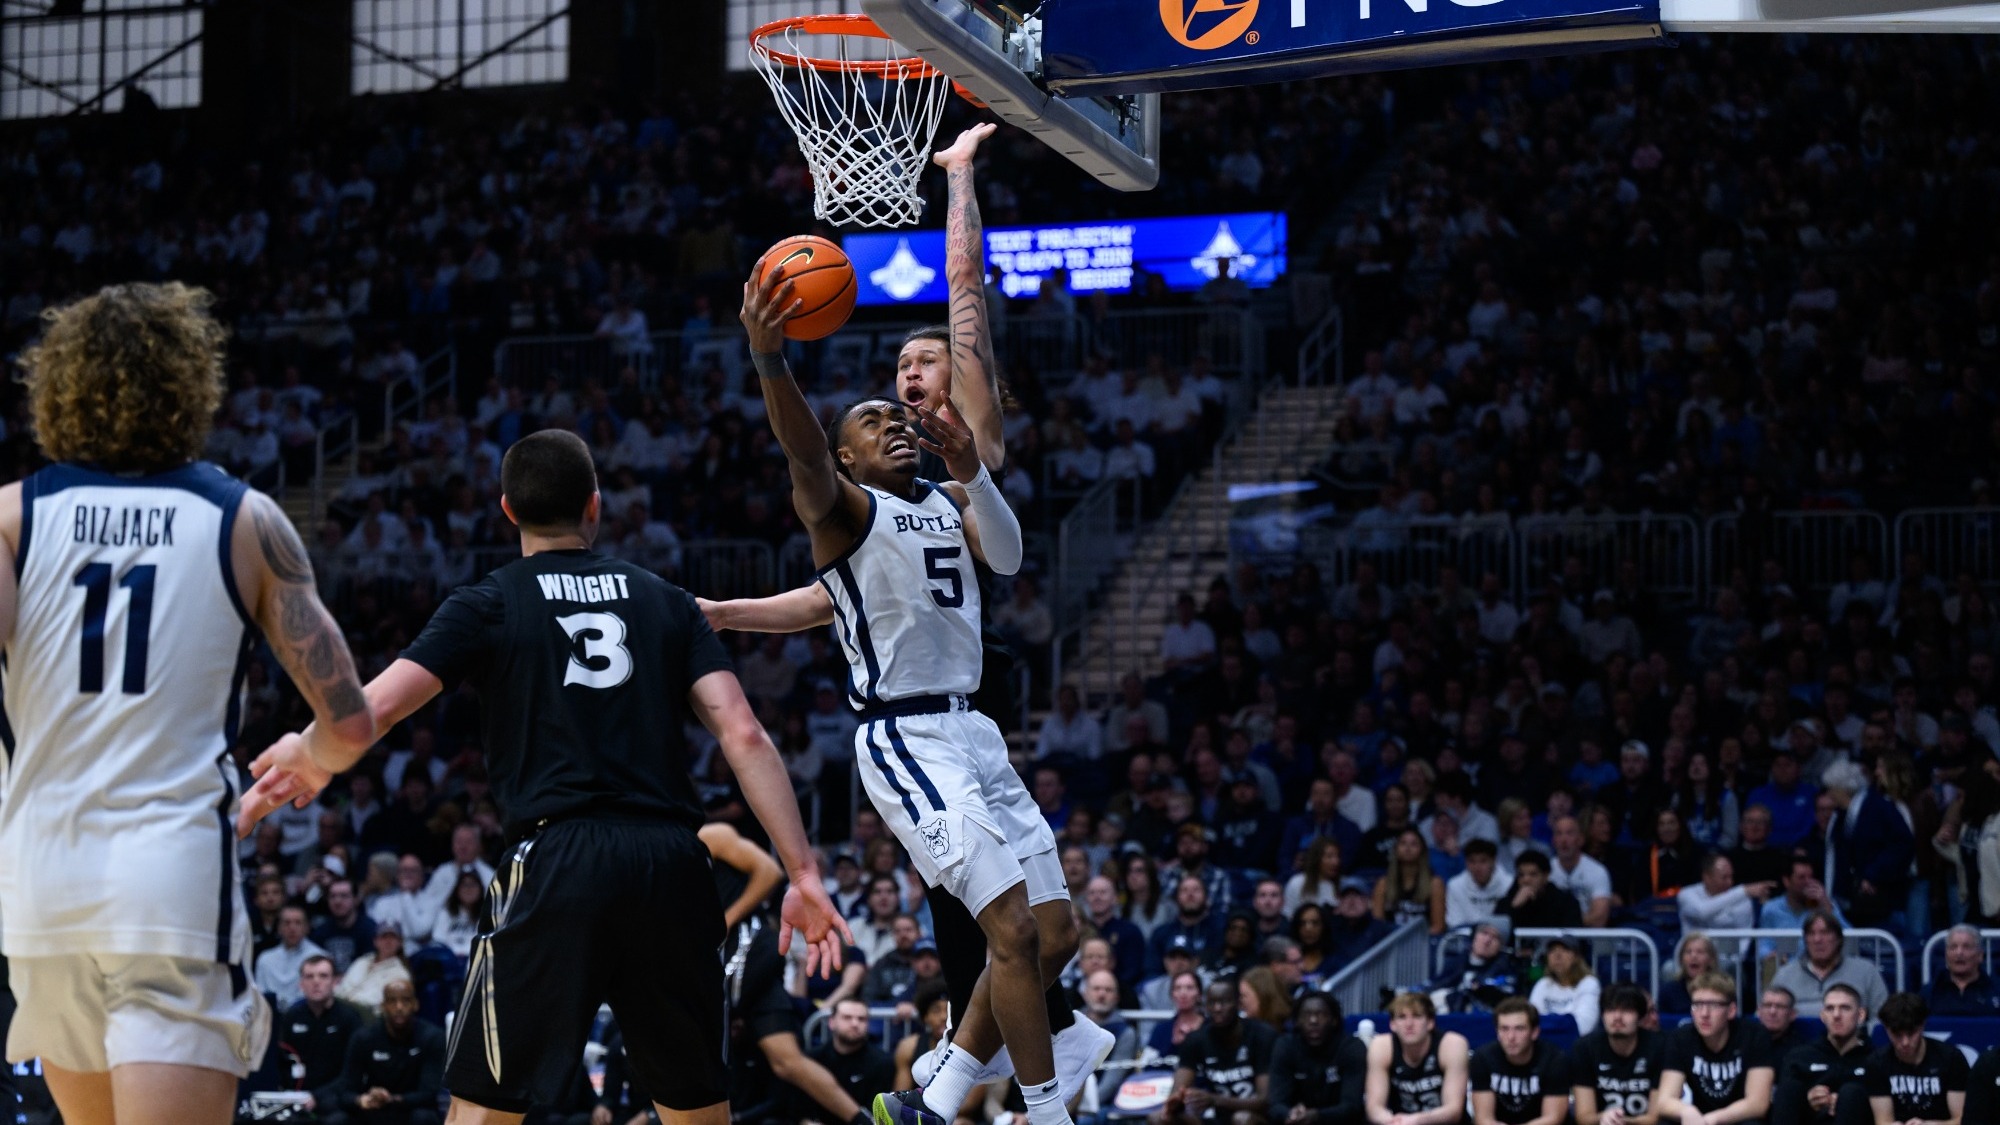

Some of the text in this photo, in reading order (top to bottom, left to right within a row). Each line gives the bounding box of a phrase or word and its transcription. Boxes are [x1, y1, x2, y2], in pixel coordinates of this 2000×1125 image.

[74, 505, 176, 547] BIZJACK
[536, 573, 630, 603] WRIGHT
[923, 546, 964, 608] 5
[74, 563, 157, 693] 11
[555, 611, 634, 689] 3
[1889, 1075, 1942, 1096] XAVIER
